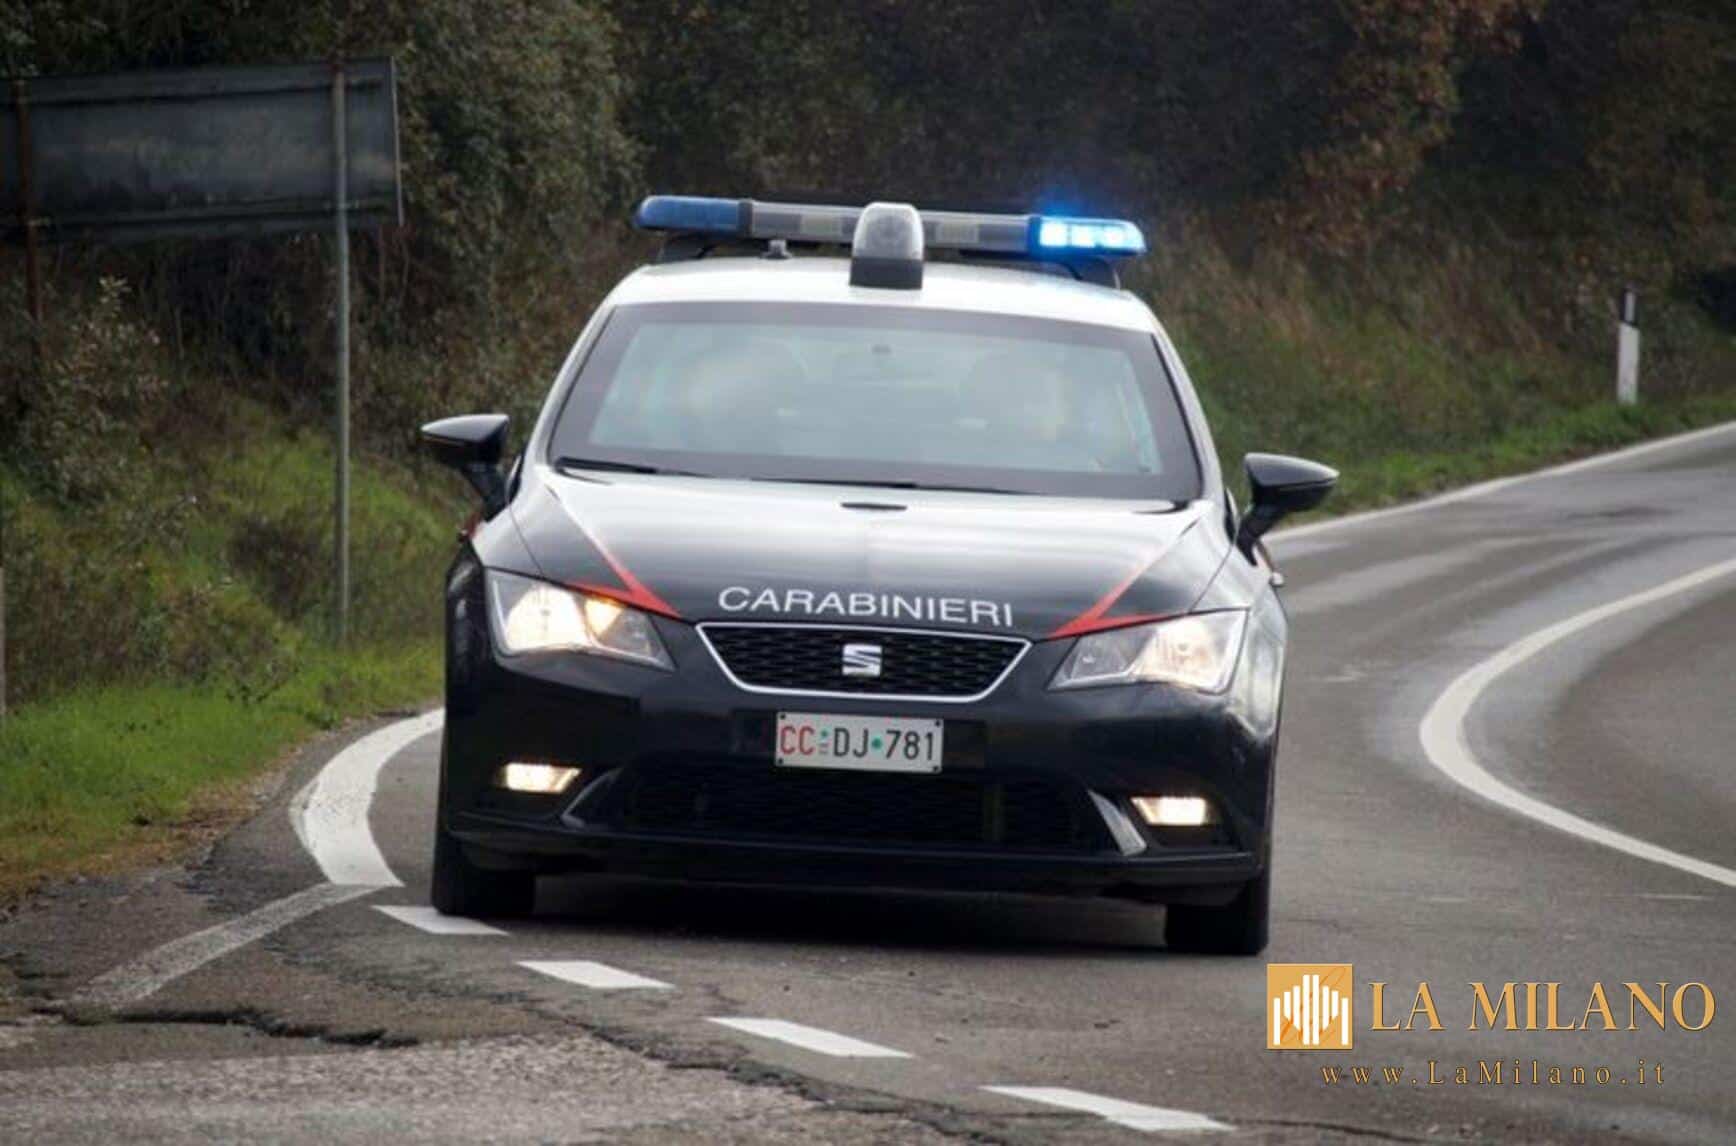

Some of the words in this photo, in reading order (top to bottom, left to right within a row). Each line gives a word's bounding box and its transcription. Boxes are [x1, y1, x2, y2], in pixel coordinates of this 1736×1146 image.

[717, 586, 1014, 627] CARABINIERI
[779, 725, 815, 756] CC
[885, 729, 934, 761] 781
